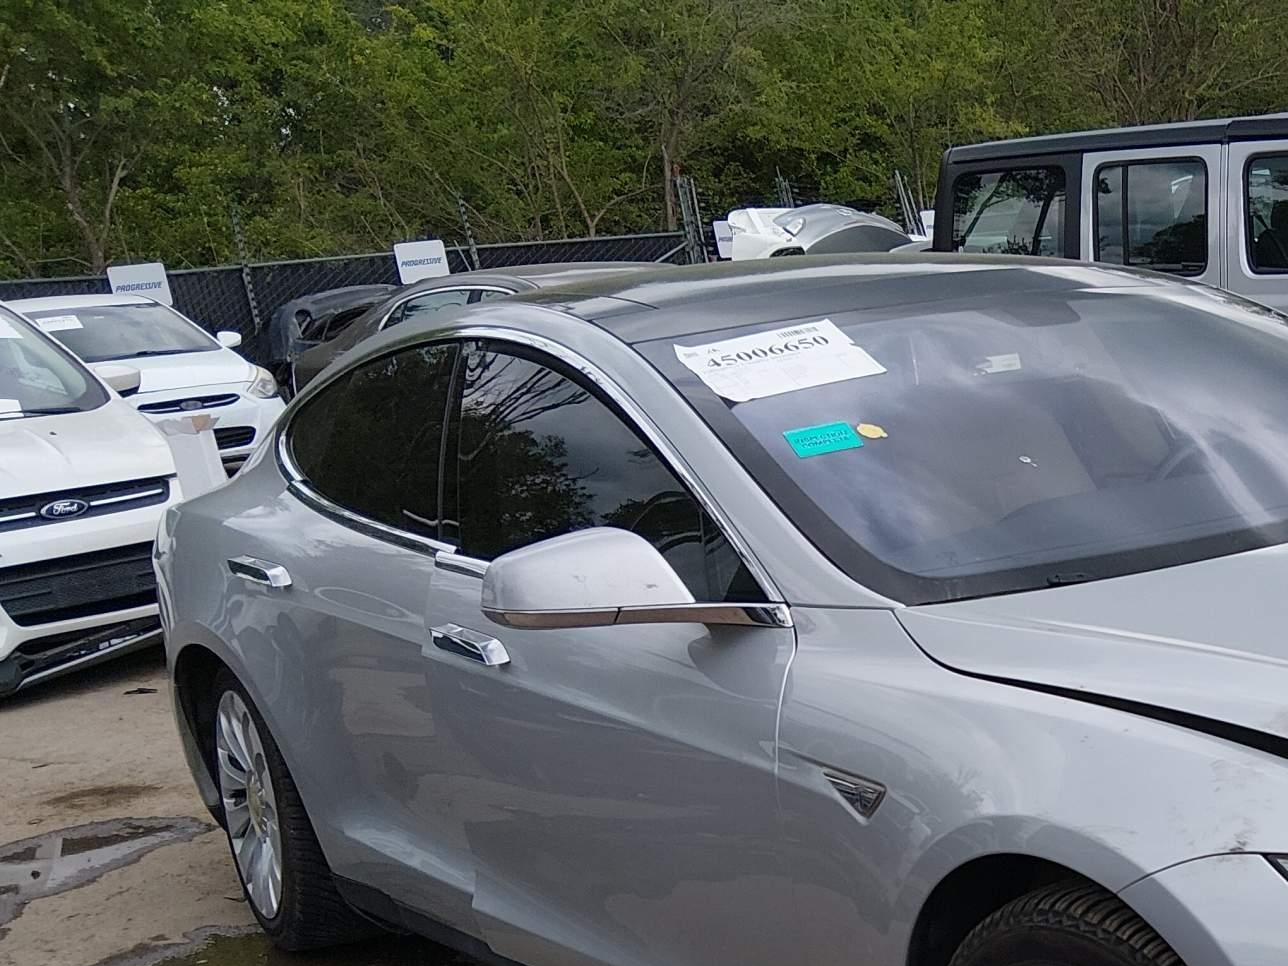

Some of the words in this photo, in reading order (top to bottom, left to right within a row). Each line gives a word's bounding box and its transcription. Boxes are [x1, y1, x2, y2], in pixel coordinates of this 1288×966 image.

[401, 256, 442, 267] PROGRESSIVE
[115, 281, 162, 293] PROGRESSIVE
[707, 335, 829, 368] 45006650
